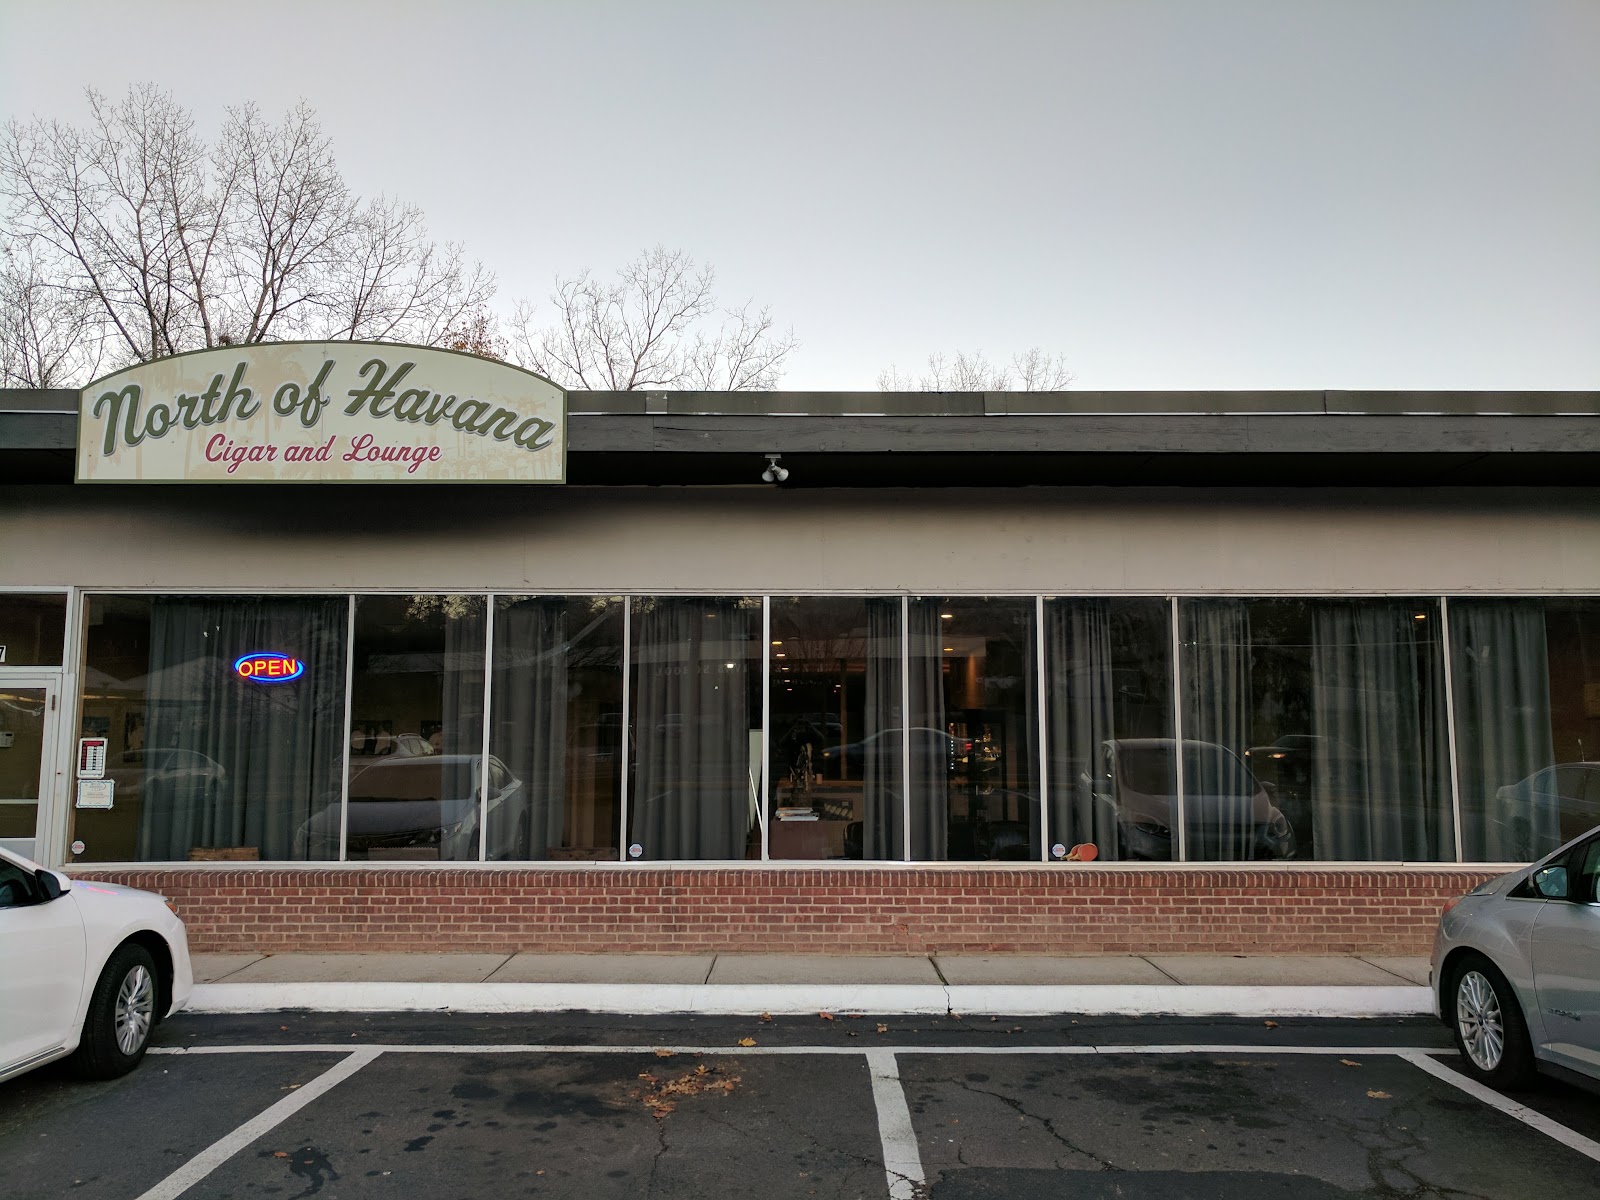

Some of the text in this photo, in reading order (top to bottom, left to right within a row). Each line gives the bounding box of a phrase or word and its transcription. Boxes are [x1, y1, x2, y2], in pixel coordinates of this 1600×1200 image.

[93, 358, 557, 458] North of Havana
[205, 433, 443, 473] Cigar and Lounge
[238, 658, 296, 677] OPEN
